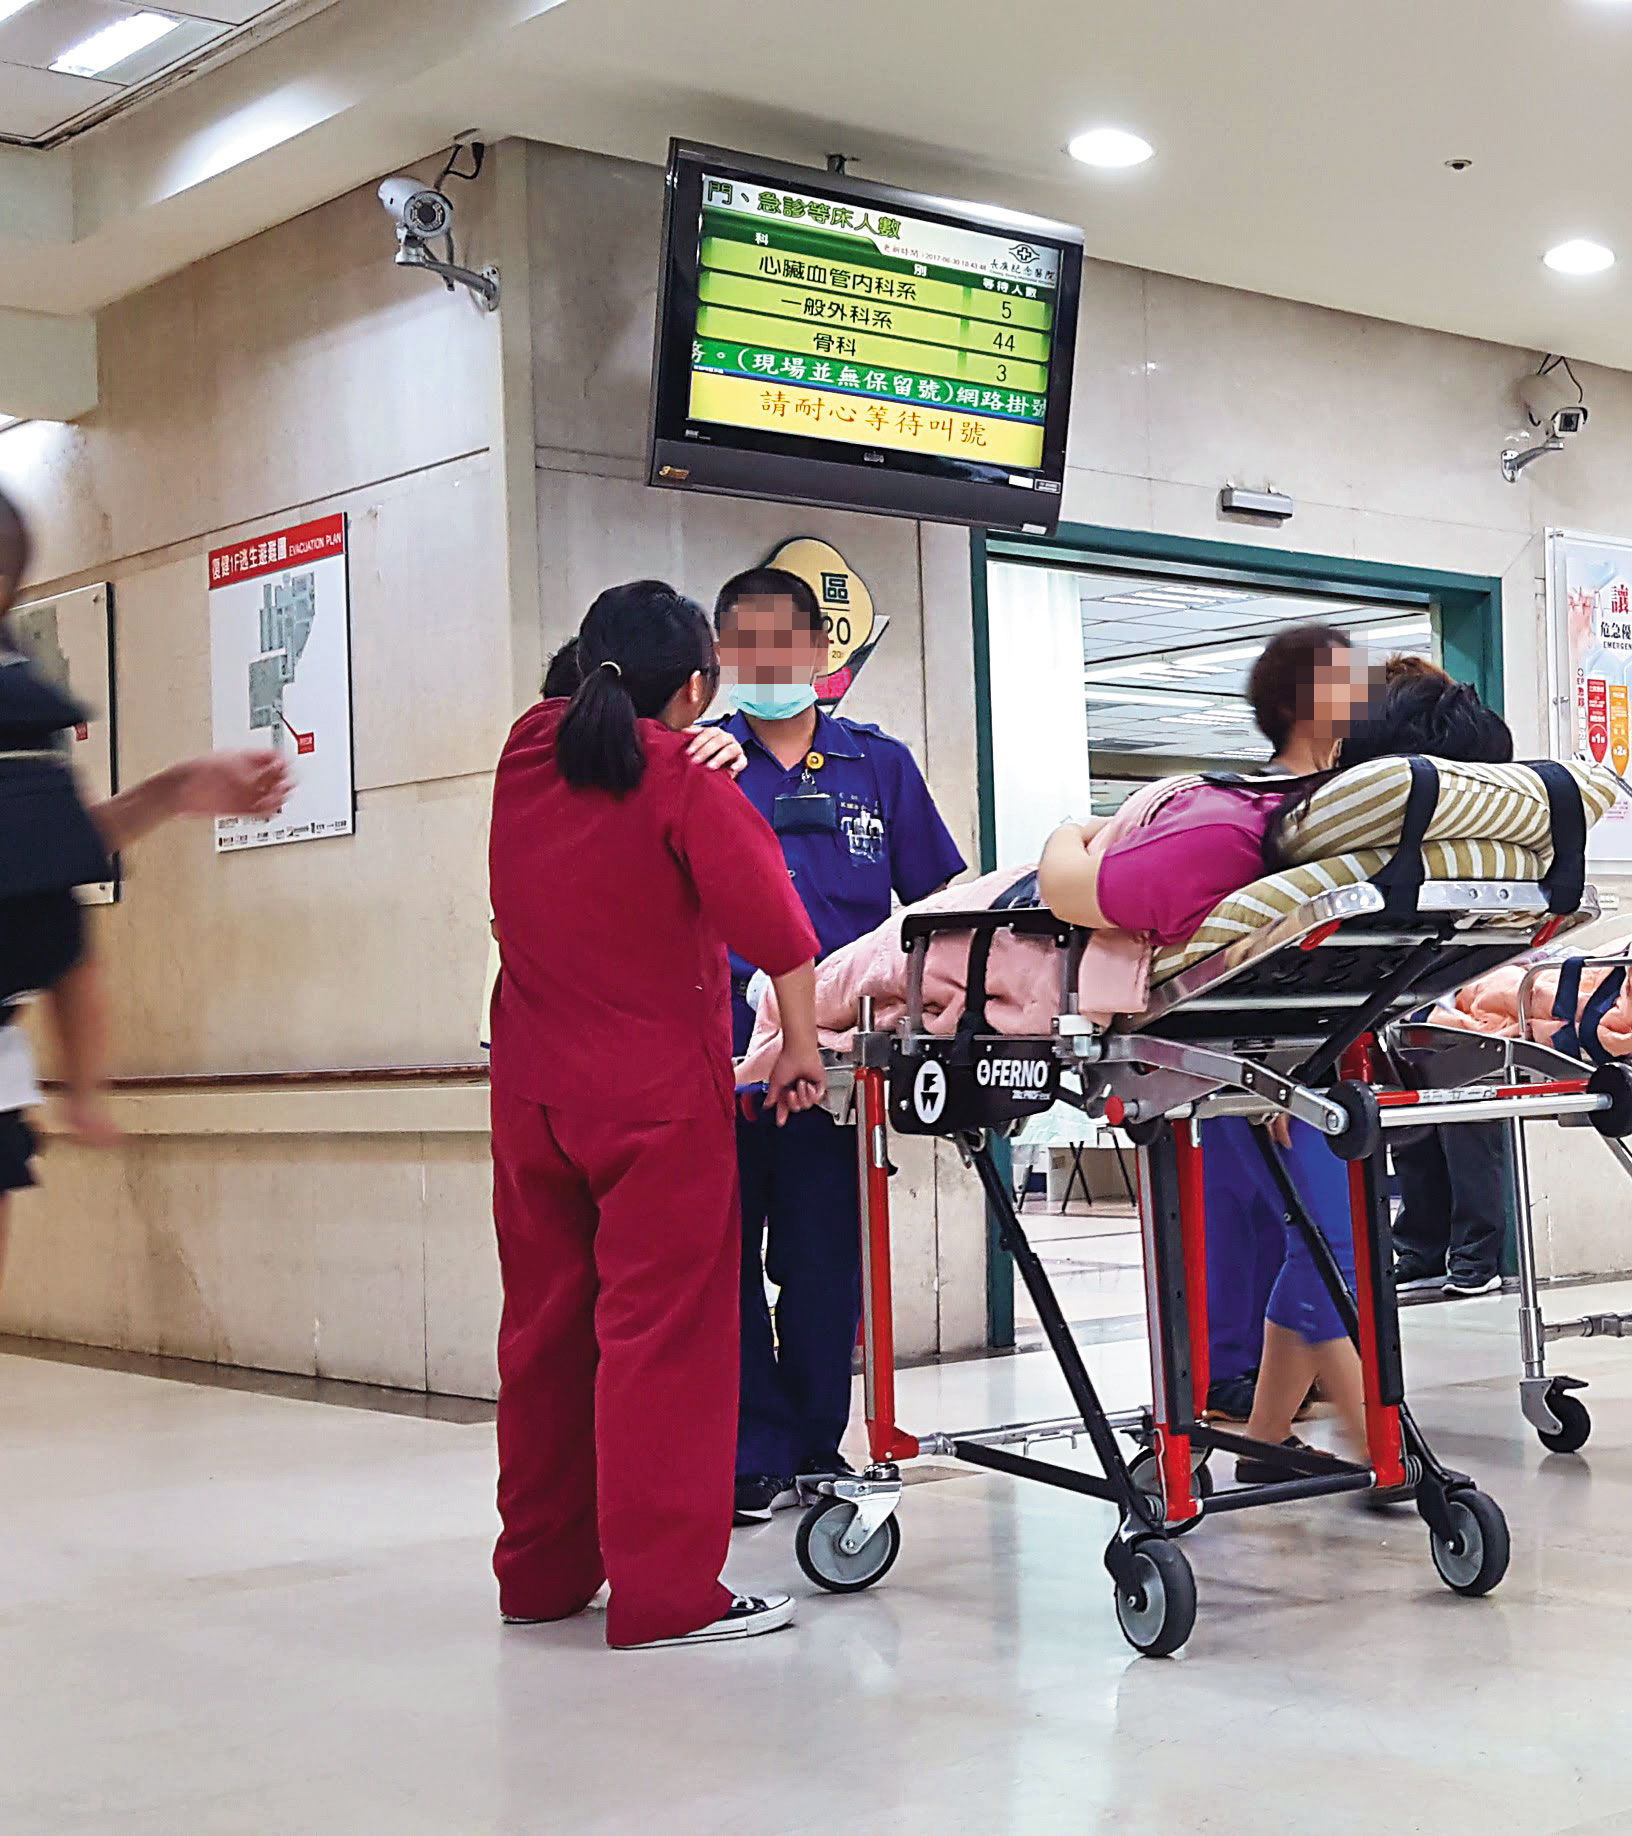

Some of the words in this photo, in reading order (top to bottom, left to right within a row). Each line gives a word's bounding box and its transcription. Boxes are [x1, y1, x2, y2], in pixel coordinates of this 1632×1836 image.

[708, 180, 902, 240] 門、急診等床人數
[755, 232, 769, 246] 科
[759, 255, 917, 301] 心臟血管內科系
[1001, 301, 1012, 319] 5
[781, 297, 893, 330] 一般外科系
[993, 332, 1016, 352] 44
[813, 333, 857, 357] 骨科
[996, 364, 1007, 382] 3
[760, 391, 987, 447] 請耐心等待叫號
[288, 537, 325, 557] EVACUATION
[325, 532, 343, 547] PLAN
[820, 572, 850, 605] 區
[1611, 584, 1630, 614] 讓
[990, 1058, 1049, 1088] FERNO
